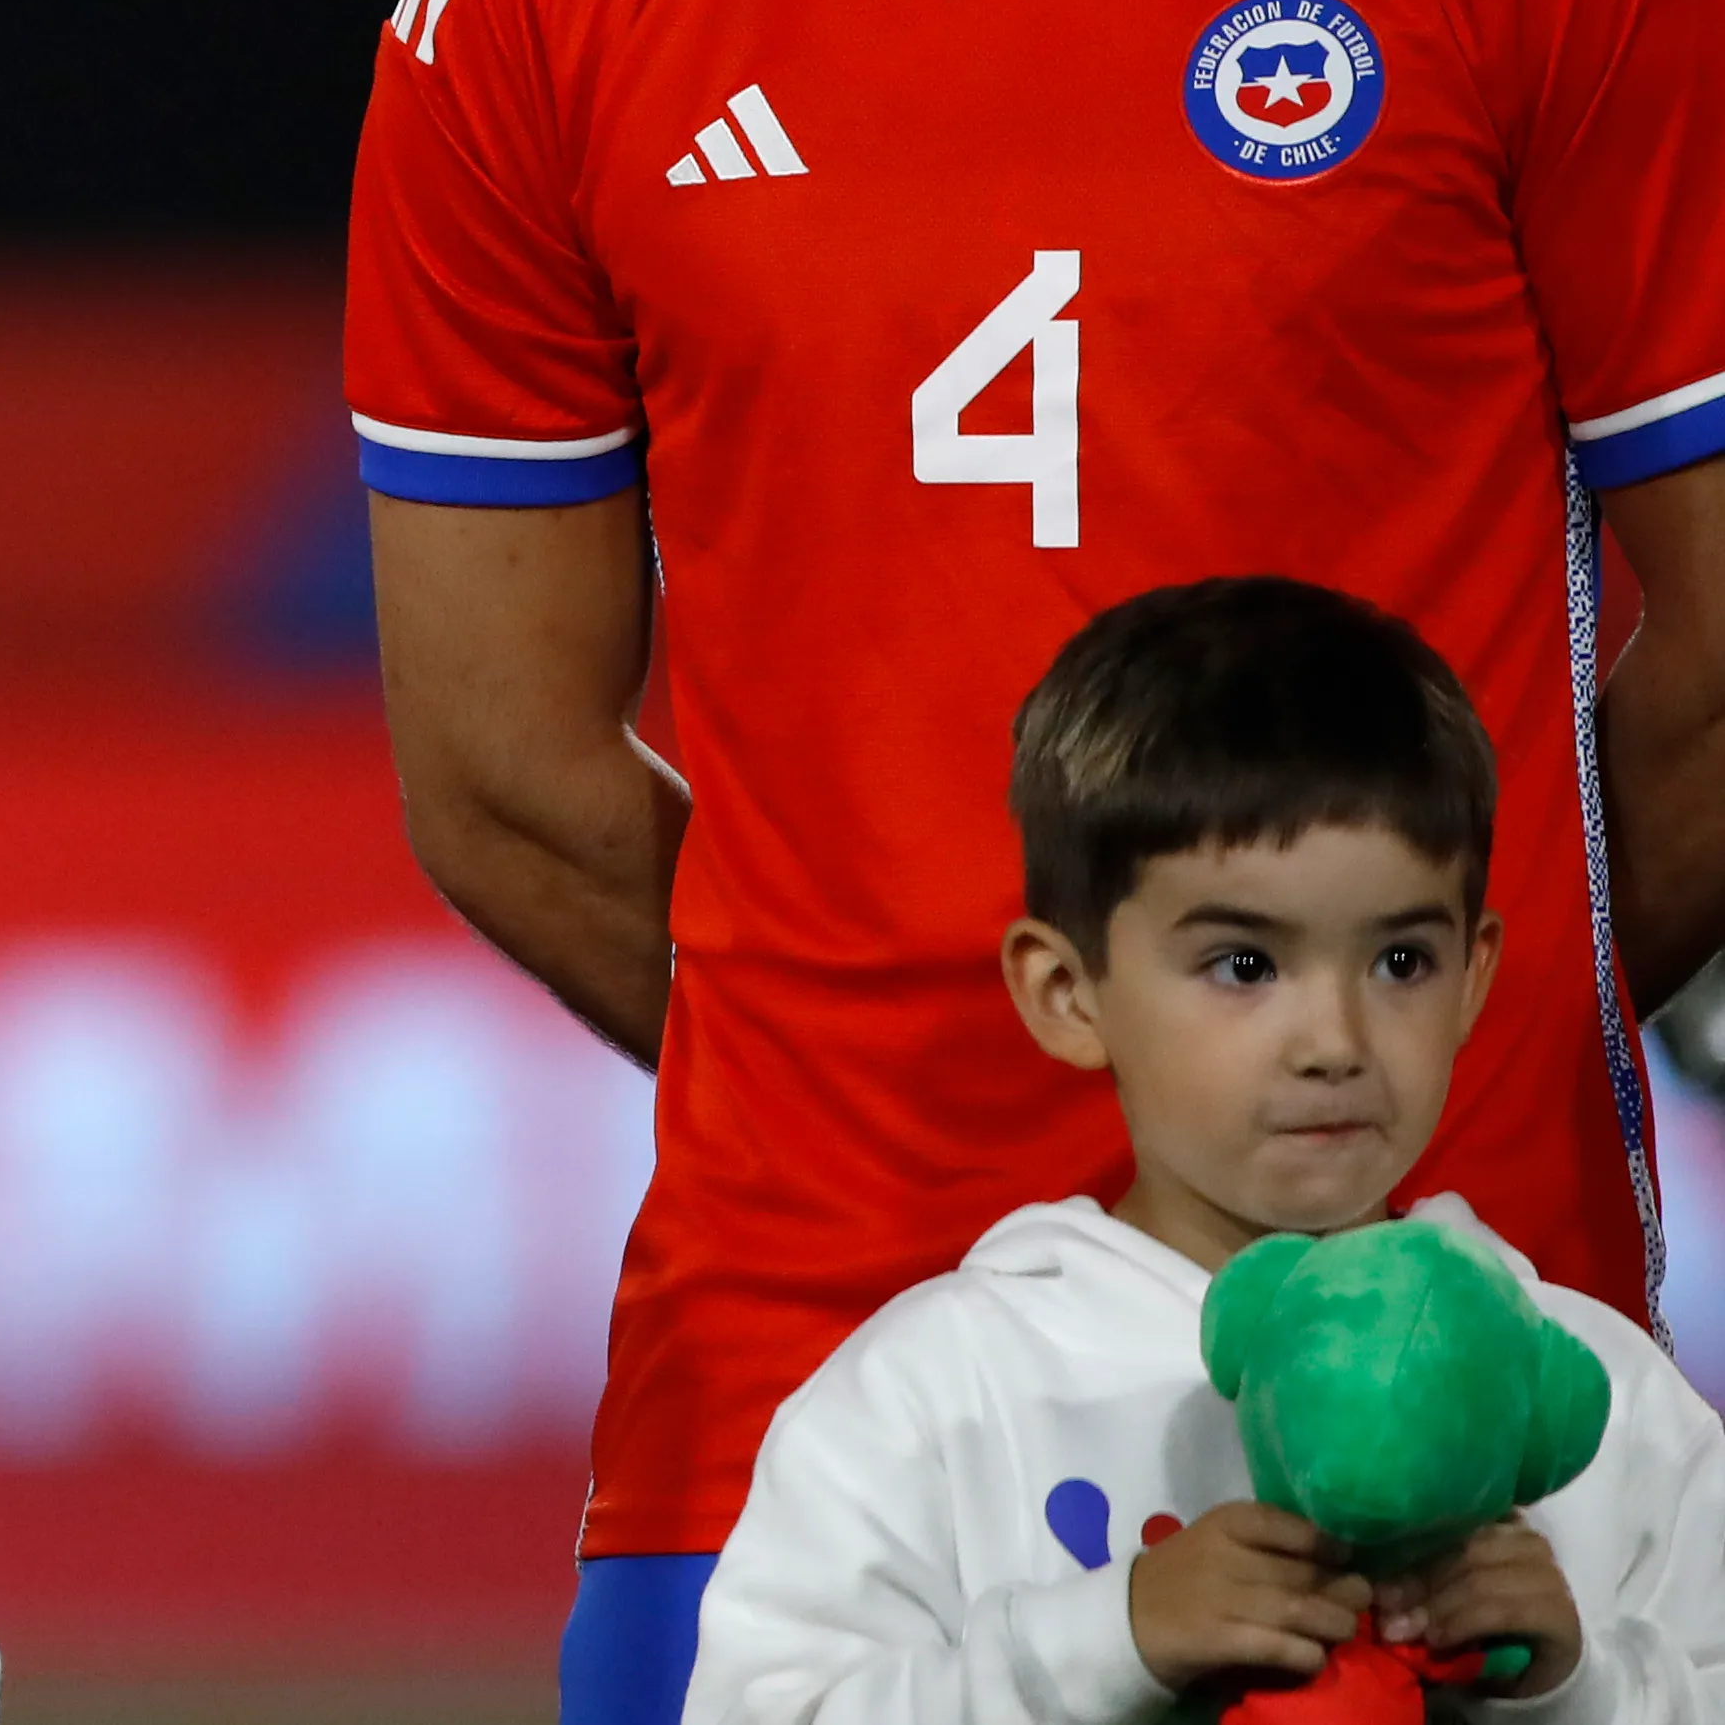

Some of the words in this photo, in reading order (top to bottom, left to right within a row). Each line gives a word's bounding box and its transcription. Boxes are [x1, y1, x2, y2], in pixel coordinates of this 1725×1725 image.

[1193, 0, 1282, 89] FEDERACION
[1297, 0, 1324, 22] DE
[1327, 13, 1376, 81] FUTBOL
[1239, 140, 1267, 164] DE
[1280, 134, 1338, 167] CHILE
[911, 250, 1081, 548] 4
